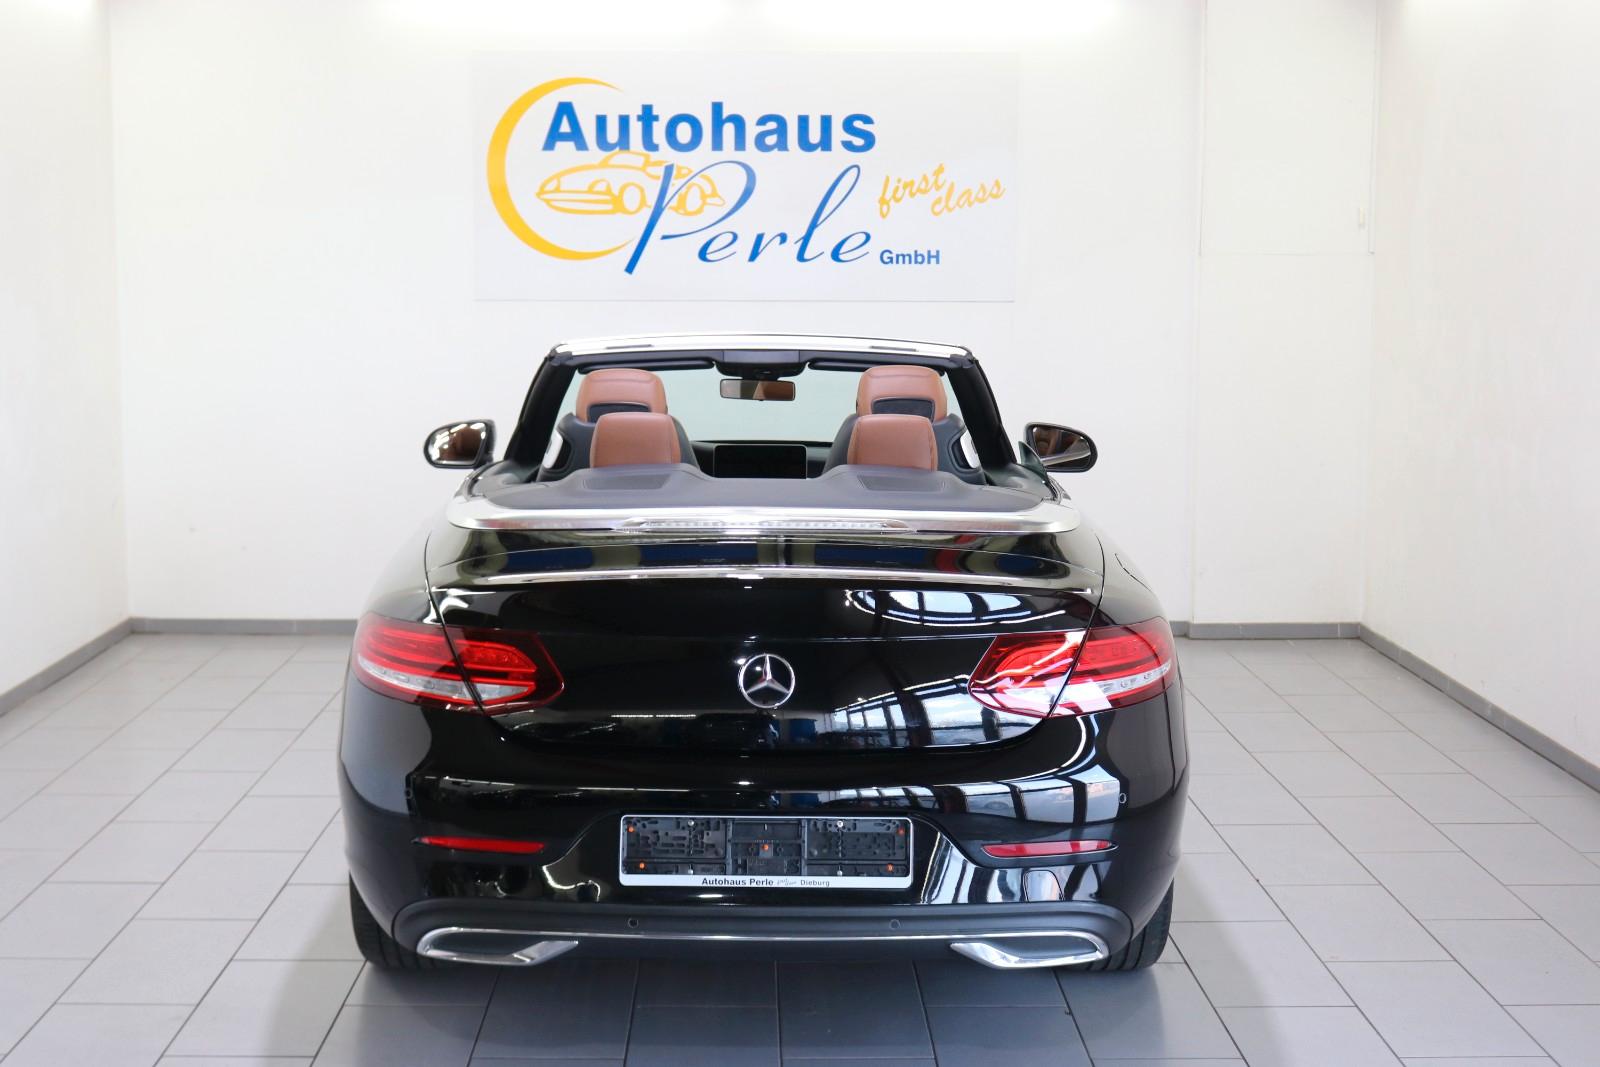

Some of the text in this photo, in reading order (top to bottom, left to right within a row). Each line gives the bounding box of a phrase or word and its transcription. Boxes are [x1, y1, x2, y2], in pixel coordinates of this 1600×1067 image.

[543, 101, 876, 153] Autohaus
[625, 160, 941, 275] Perle GmbH
[878, 163, 1006, 219] first class
[701, 877, 747, 886] Autohaus
[749, 878, 774, 886] Perle
[800, 879, 830, 888] Dieburg
